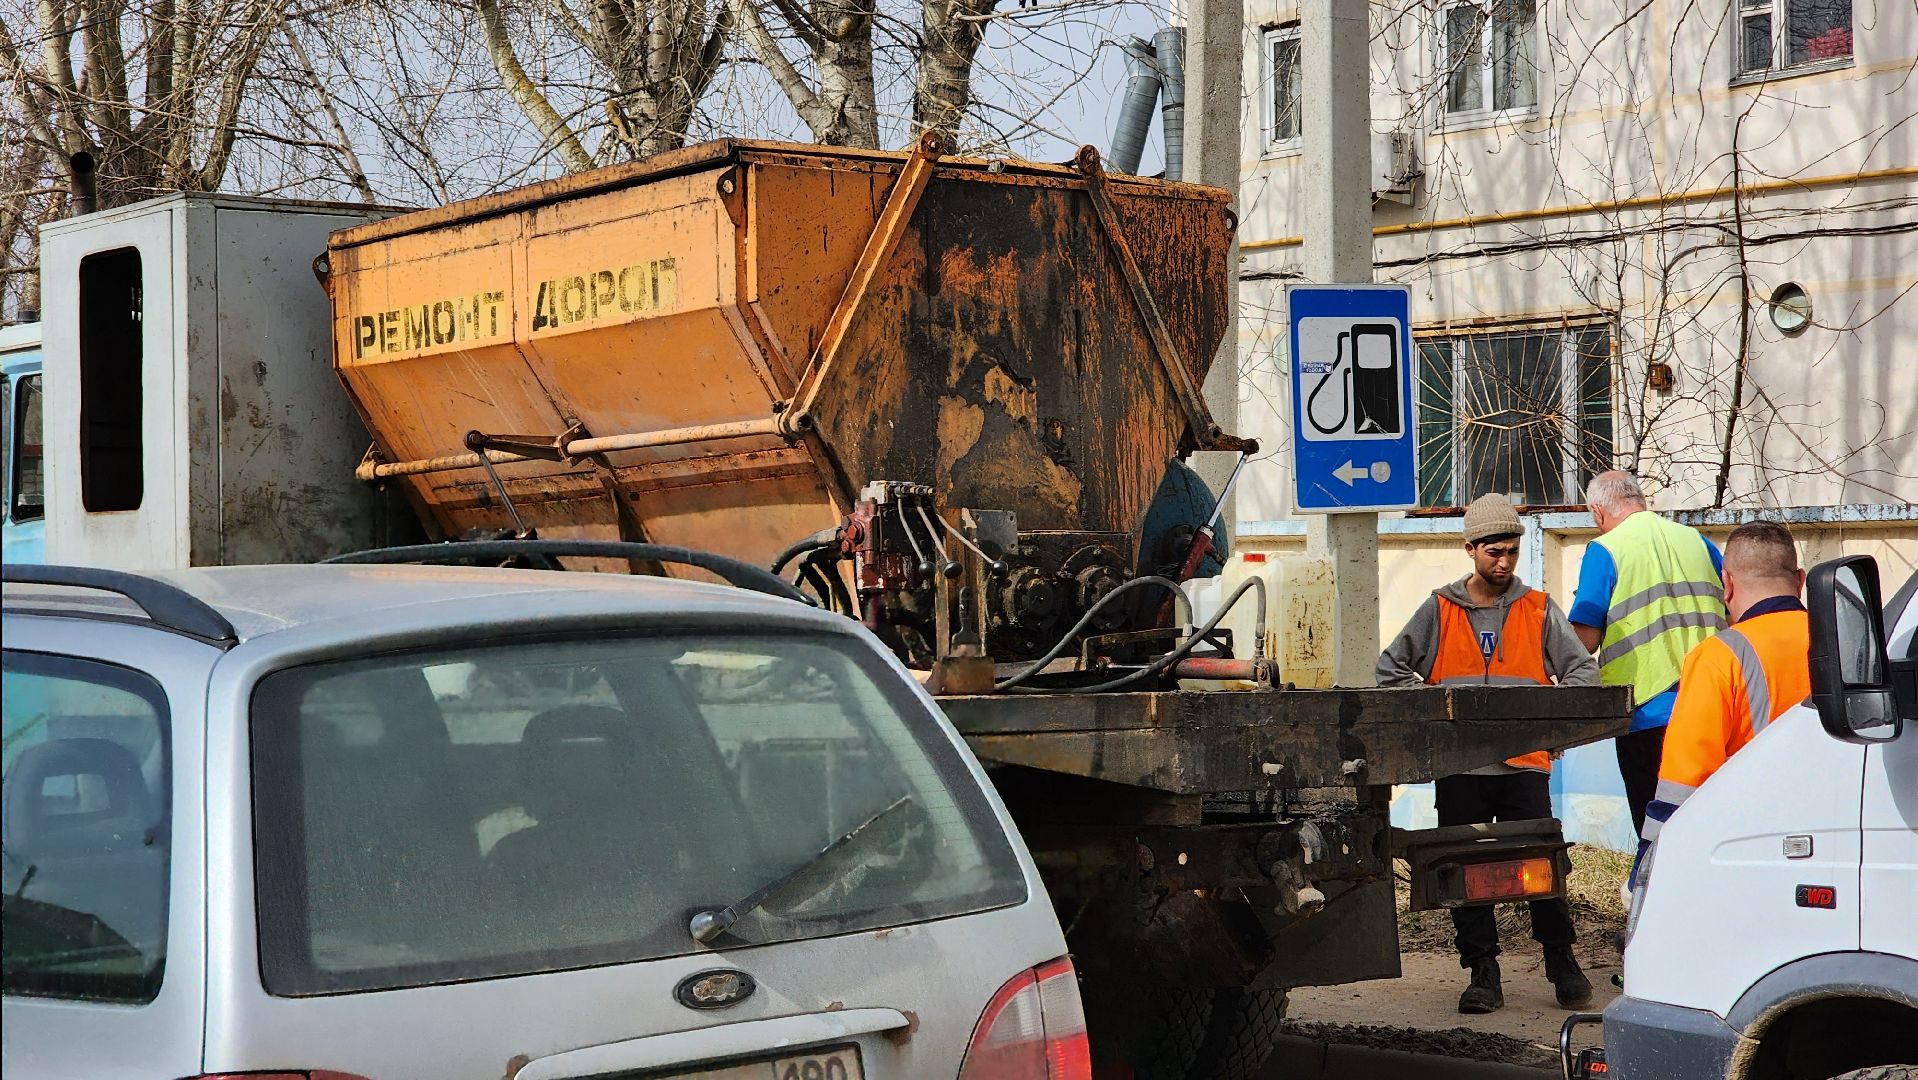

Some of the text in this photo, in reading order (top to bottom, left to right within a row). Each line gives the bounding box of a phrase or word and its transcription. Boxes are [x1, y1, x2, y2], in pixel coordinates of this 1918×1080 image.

[355, 258, 676, 359] РЕМОНТ ДОРОГ
[1797, 886, 1834, 905] 4WD
